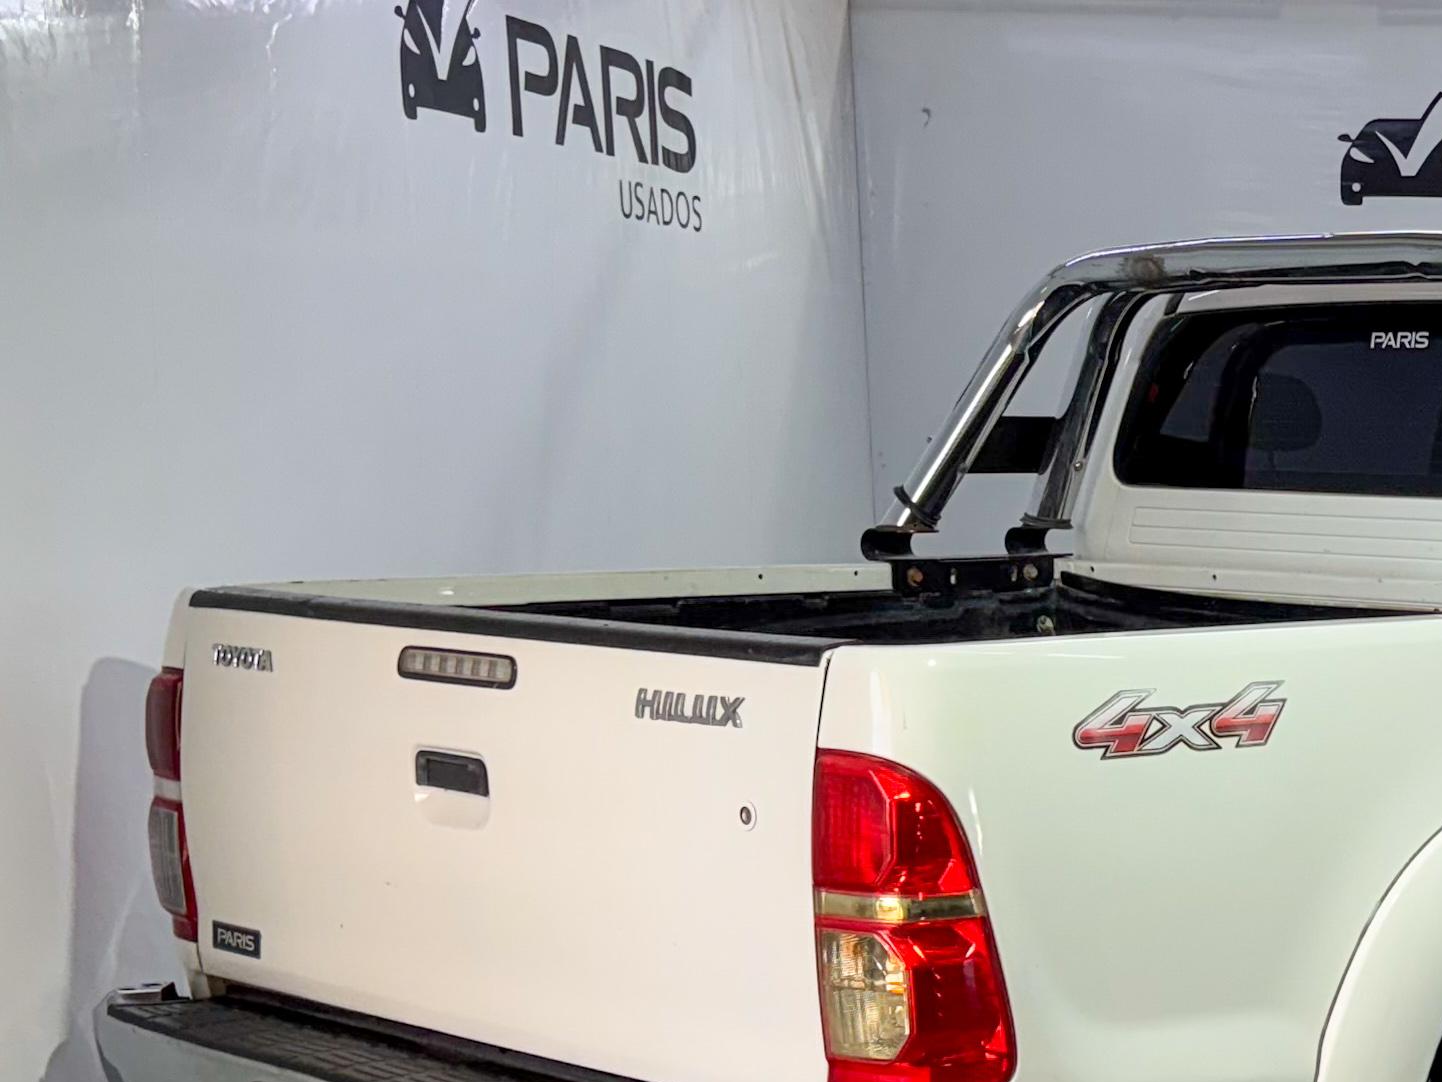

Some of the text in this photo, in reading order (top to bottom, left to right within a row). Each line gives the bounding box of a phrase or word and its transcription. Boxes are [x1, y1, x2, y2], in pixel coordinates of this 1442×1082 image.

[505, 14, 697, 173] PARIS
[619, 179, 702, 232] USADOS
[1369, 331, 1430, 349] PARIS
[212, 643, 273, 673] TOYOTA
[634, 687, 746, 729] HILUX
[217, 927, 256, 951] PARIS
